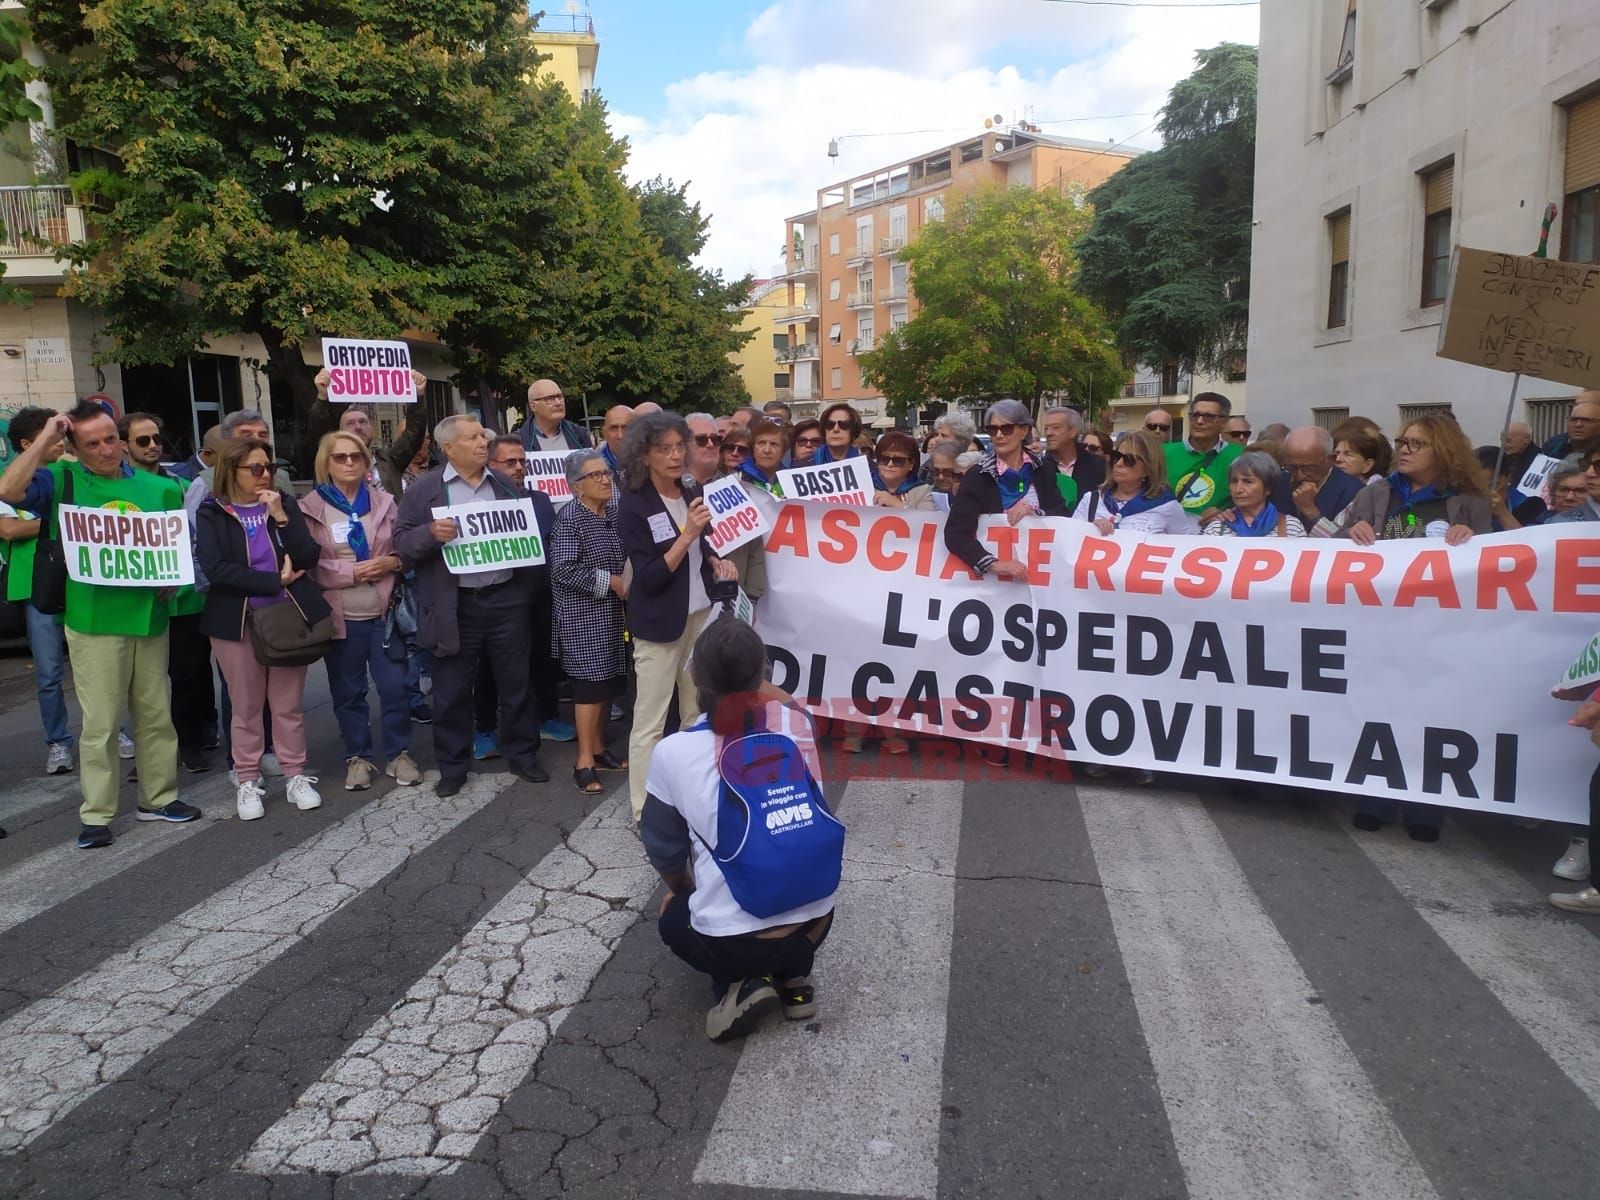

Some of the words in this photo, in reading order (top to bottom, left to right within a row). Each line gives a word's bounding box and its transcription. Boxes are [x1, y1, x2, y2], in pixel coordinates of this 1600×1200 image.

[328, 345, 409, 368] ORTOPEDIA
[330, 368, 412, 396] SUBITO!
[791, 464, 860, 497] BASTA
[1523, 472, 1544, 490] UN
[708, 484, 748, 514] CUBA
[64, 511, 183, 547] INCAPACI?
[466, 508, 528, 537] STIAMO
[710, 506, 759, 549] DOPO?
[78, 546, 93, 577] A
[99, 548, 181, 581] CASA!!!
[443, 535, 542, 567] DIFENDENDO
[1073, 535, 1600, 613] RESPIRARE
[882, 591, 1348, 695] L'OSPEDALE
[763, 643, 827, 707] DI
[851, 660, 1519, 804] CASTROVILLARI
[767, 785, 795, 796] Sempre
[767, 794, 794, 806] viaggio
[794, 792, 808, 800] con
[766, 802, 813, 830] AVIS
